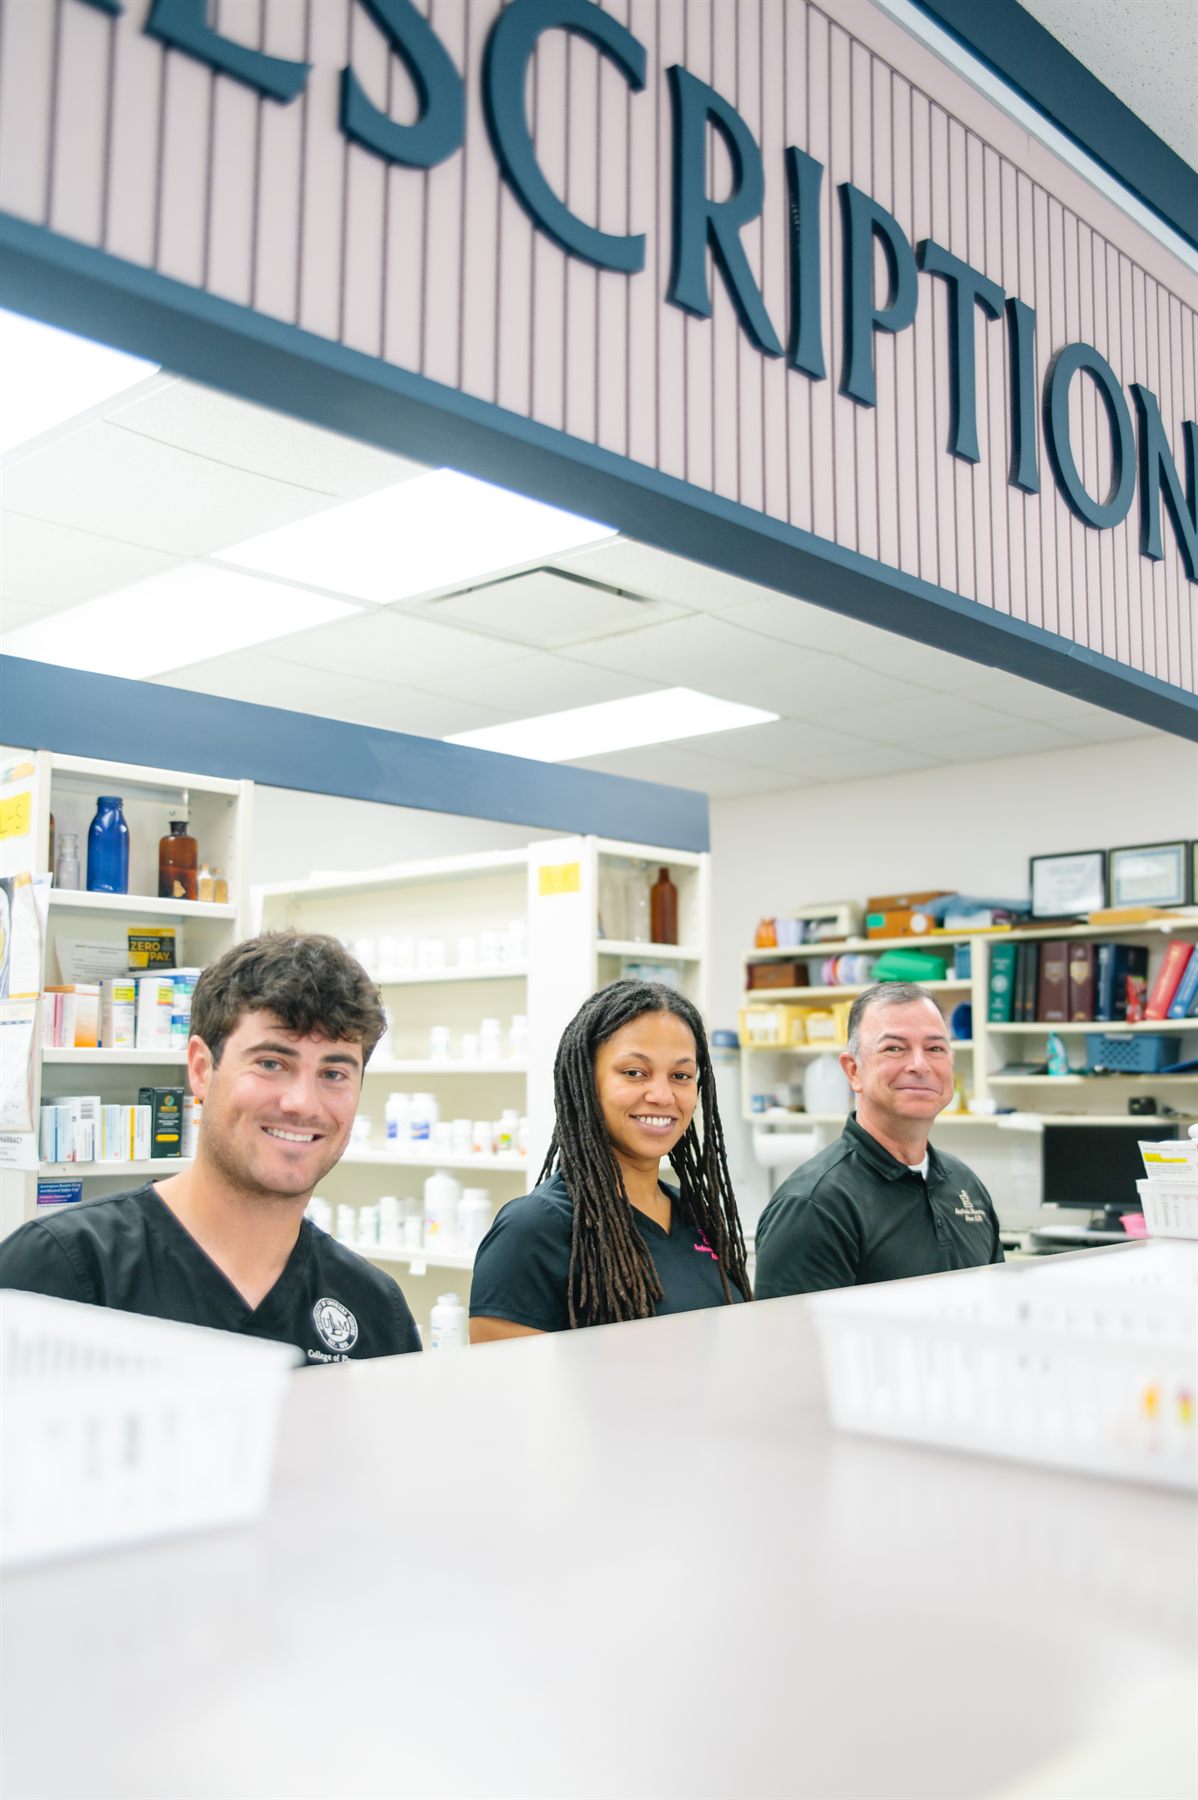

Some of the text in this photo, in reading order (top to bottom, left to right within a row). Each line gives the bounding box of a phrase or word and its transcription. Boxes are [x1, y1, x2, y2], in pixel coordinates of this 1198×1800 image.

[130, 941, 161, 952] ZERO
[308, 1349, 332, 1363] College
[333, 1354, 340, 1362] of
